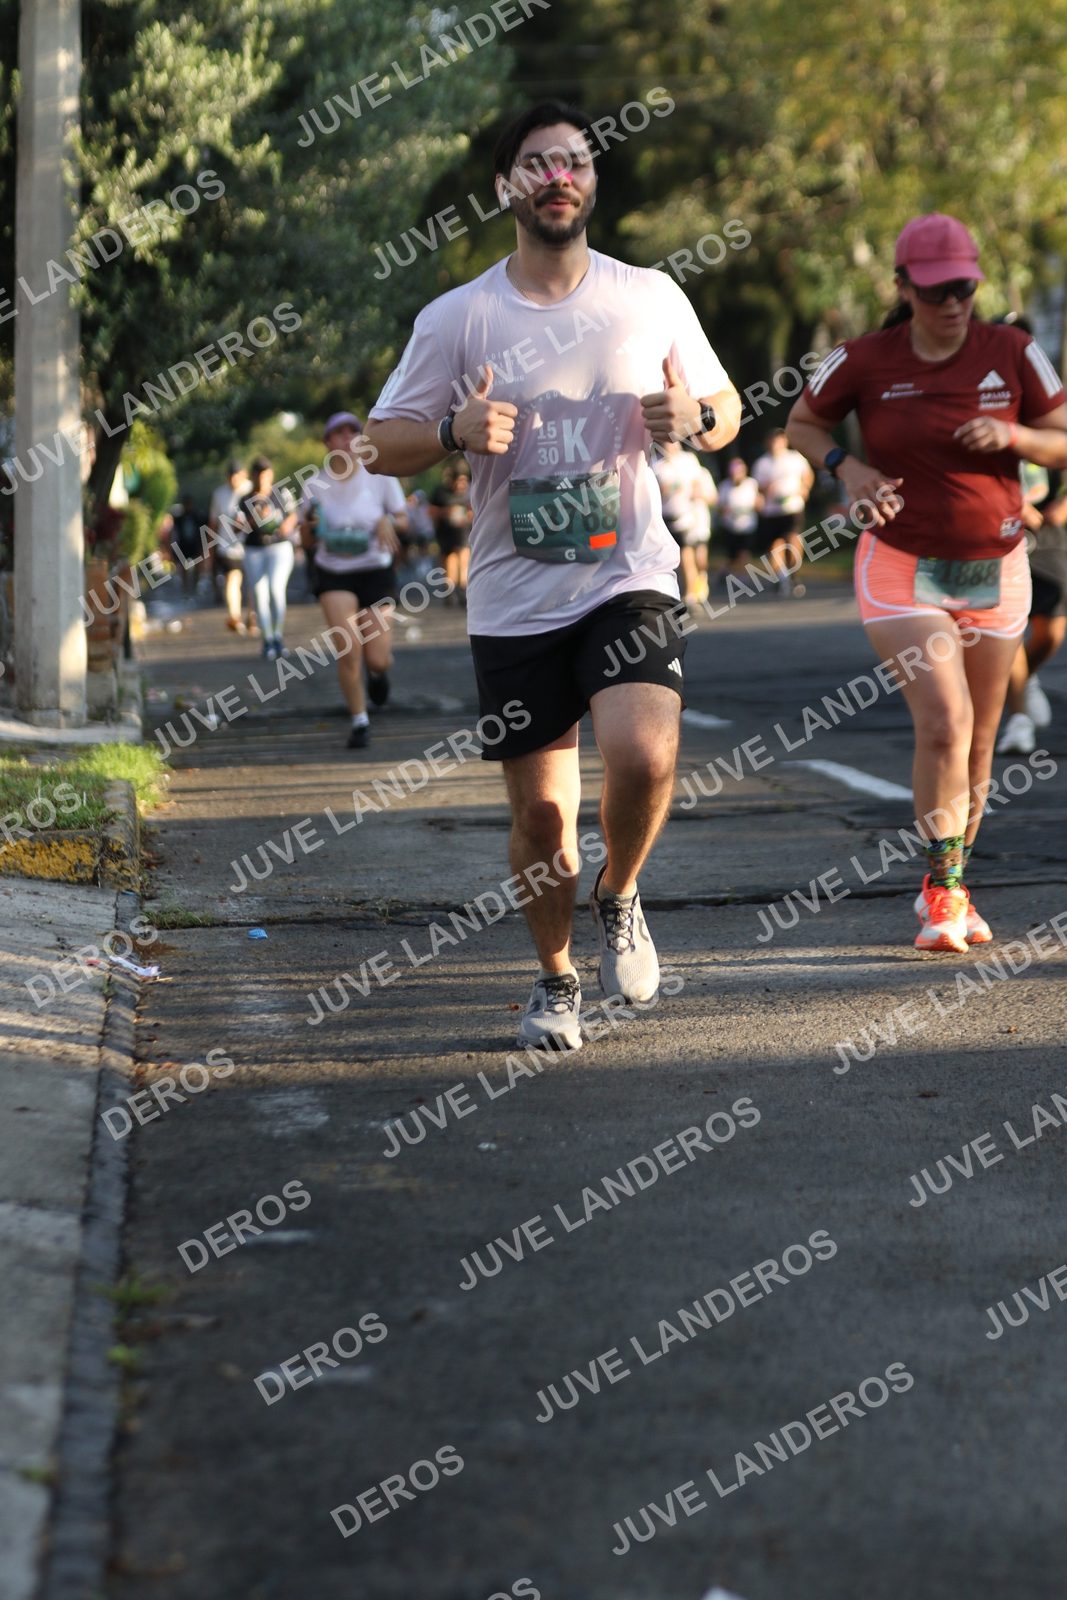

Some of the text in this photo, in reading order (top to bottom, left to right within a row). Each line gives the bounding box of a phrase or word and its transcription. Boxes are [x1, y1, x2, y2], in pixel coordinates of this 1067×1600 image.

[562, 417, 591, 463] K
[538, 447, 559, 465] 30
[564, 547, 576, 561] G
